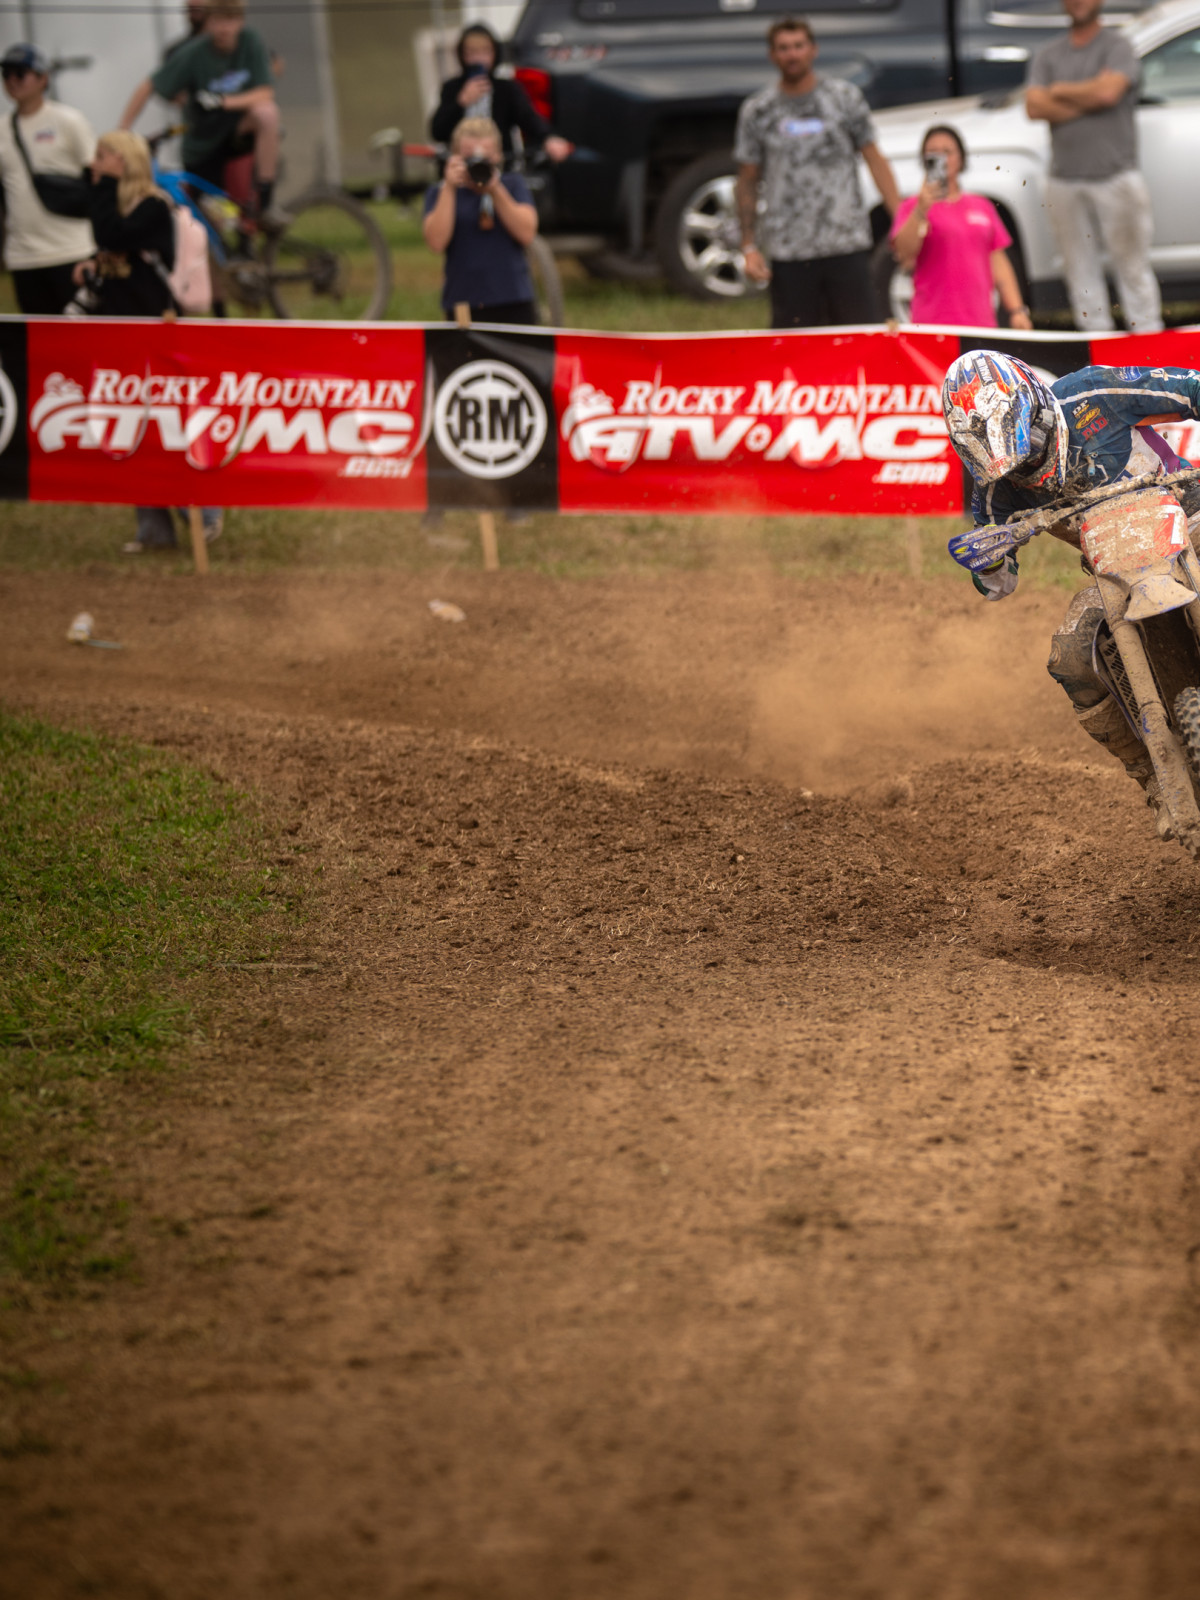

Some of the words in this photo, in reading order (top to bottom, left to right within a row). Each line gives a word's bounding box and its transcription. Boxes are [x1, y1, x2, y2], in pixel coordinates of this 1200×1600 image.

[88, 367, 210, 403] ROCKY
[213, 371, 417, 410] MOUNTAIN
[619, 380, 746, 416] ROCKY
[748, 380, 944, 416] MOUNTAIN
[457, 396, 526, 443] RM
